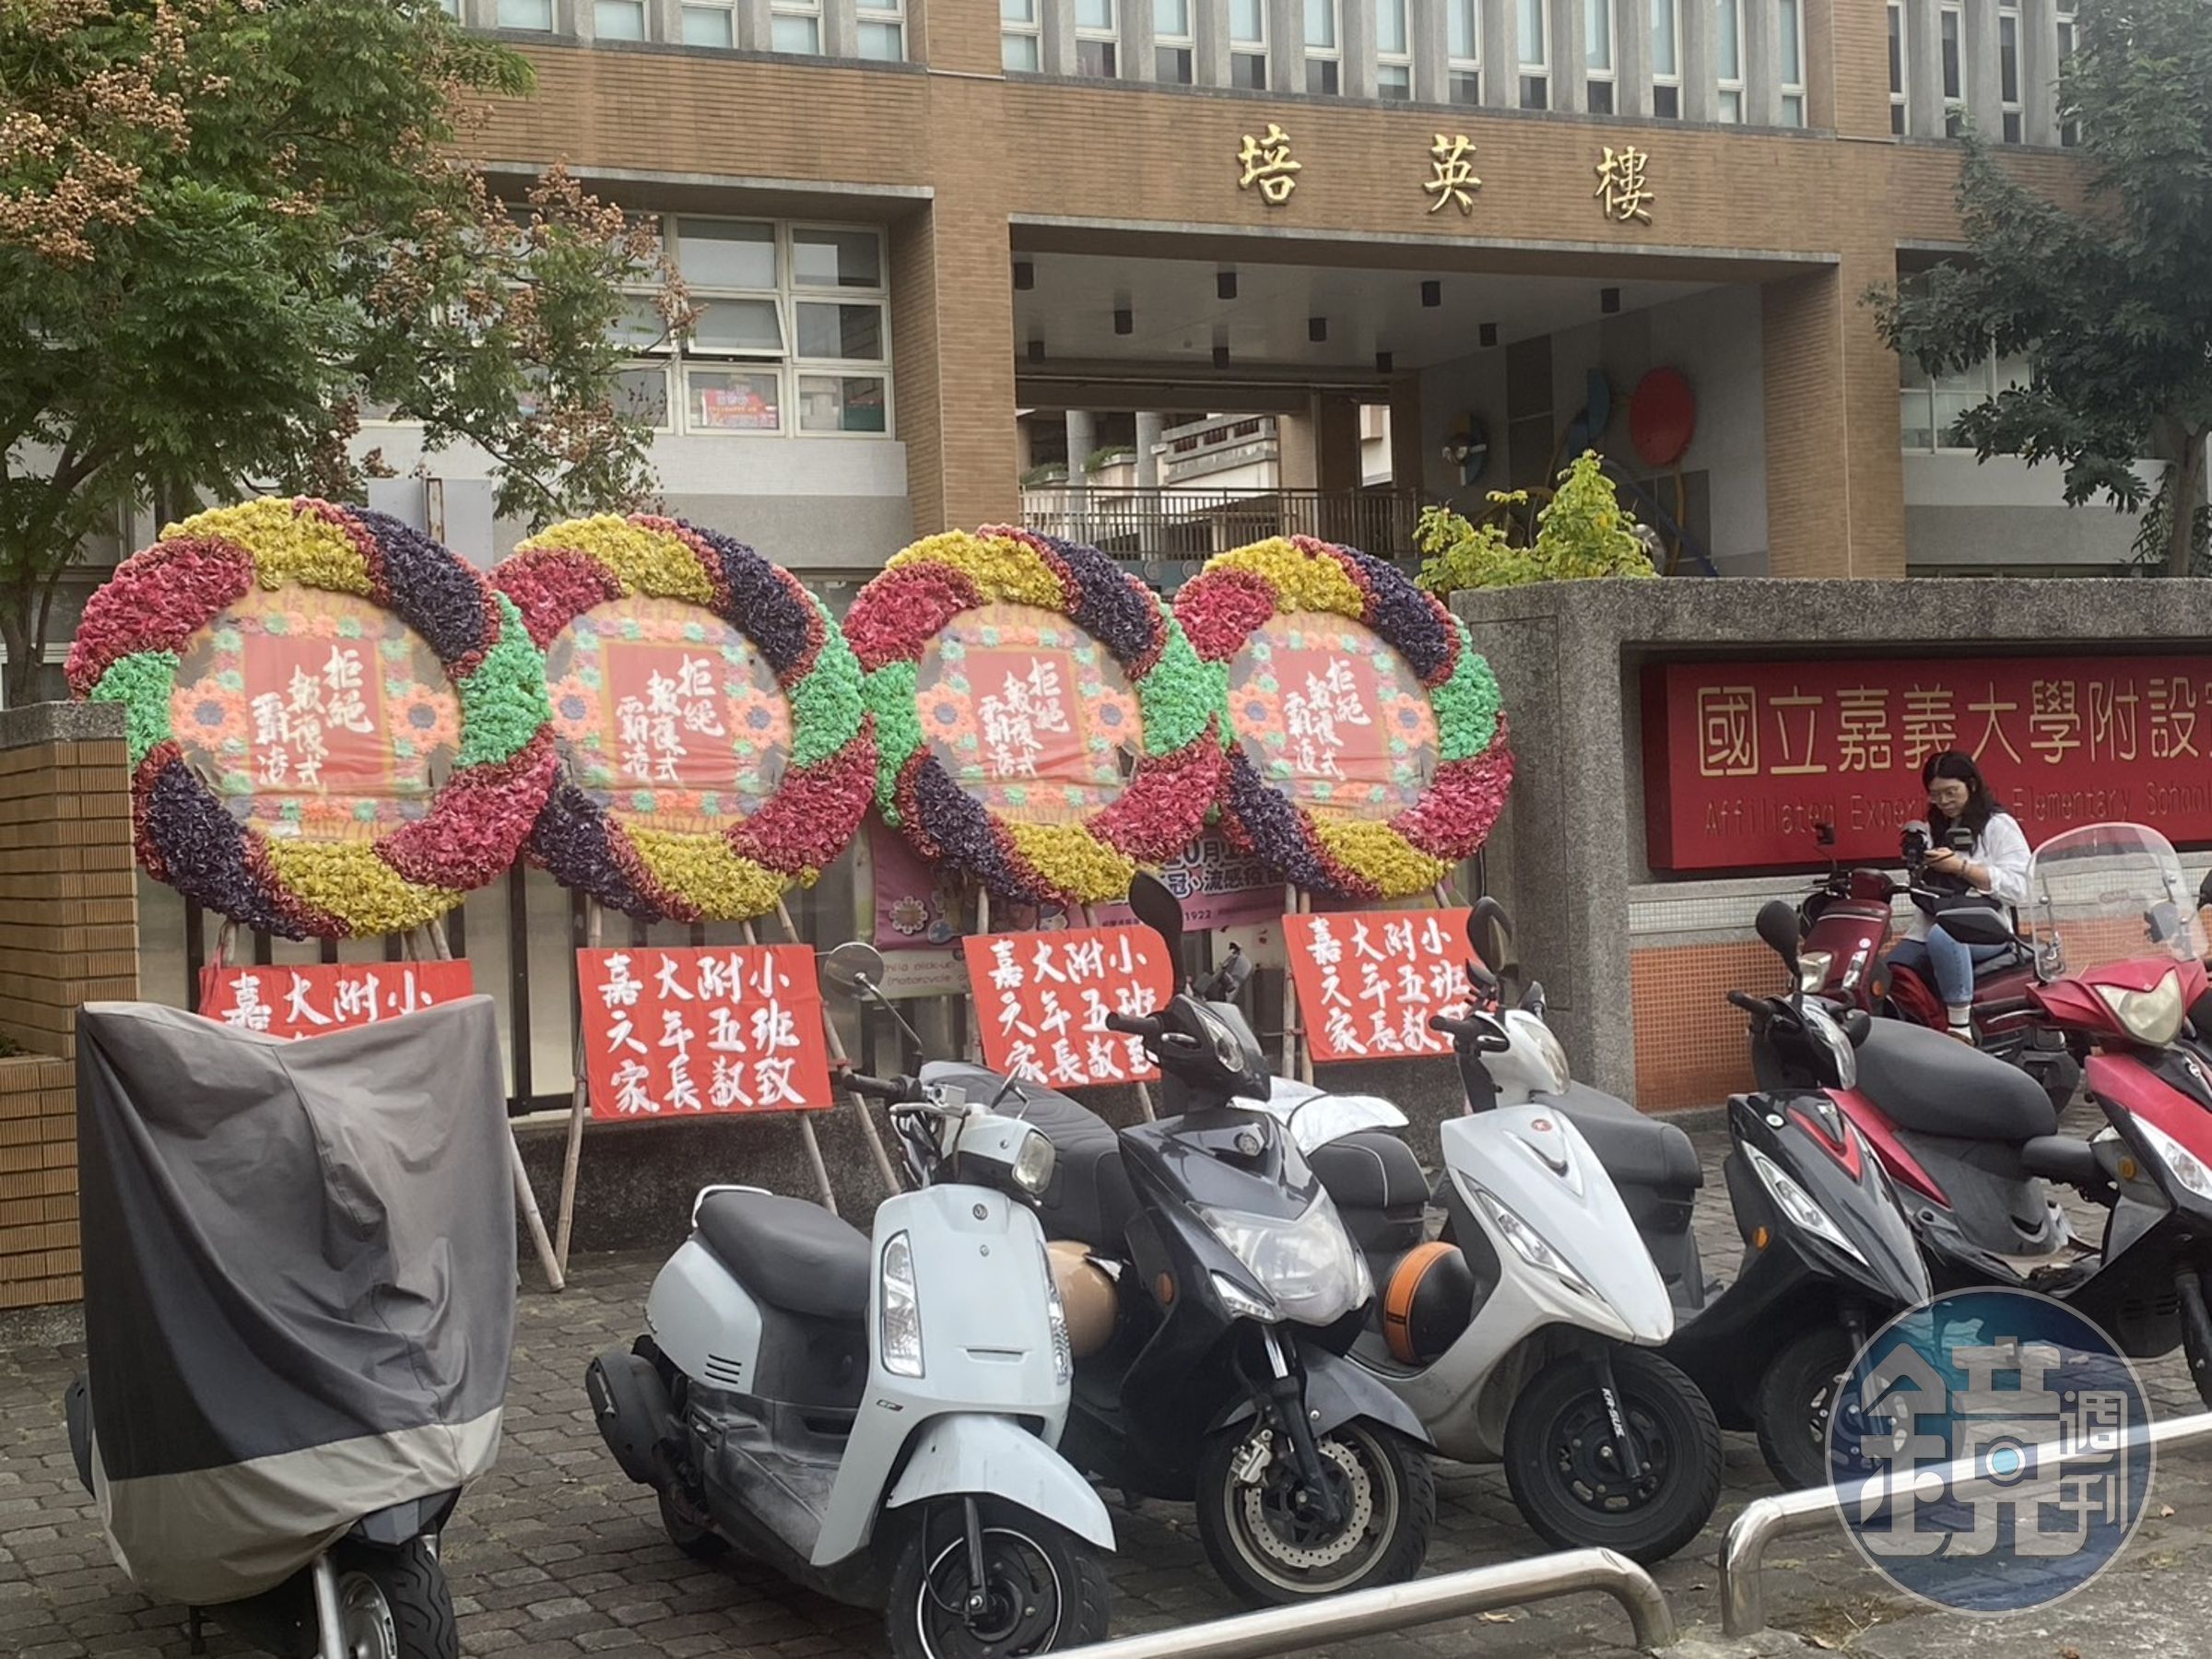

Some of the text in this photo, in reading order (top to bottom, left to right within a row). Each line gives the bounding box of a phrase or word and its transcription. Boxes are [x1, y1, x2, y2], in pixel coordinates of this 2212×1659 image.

[1236, 124, 1655, 227] 培英樓
[1698, 677, 2212, 777] 國立嘉義大學附設
[988, 934, 1147, 990] 嘉大附小
[1306, 915, 1453, 965] 嘉大附小
[221, 970, 432, 1031] 嘉大附小
[598, 951, 790, 1008] 嘉大附小
[606, 998, 801, 1056] 六年五班
[610, 1053, 806, 1114] 家長敬致
